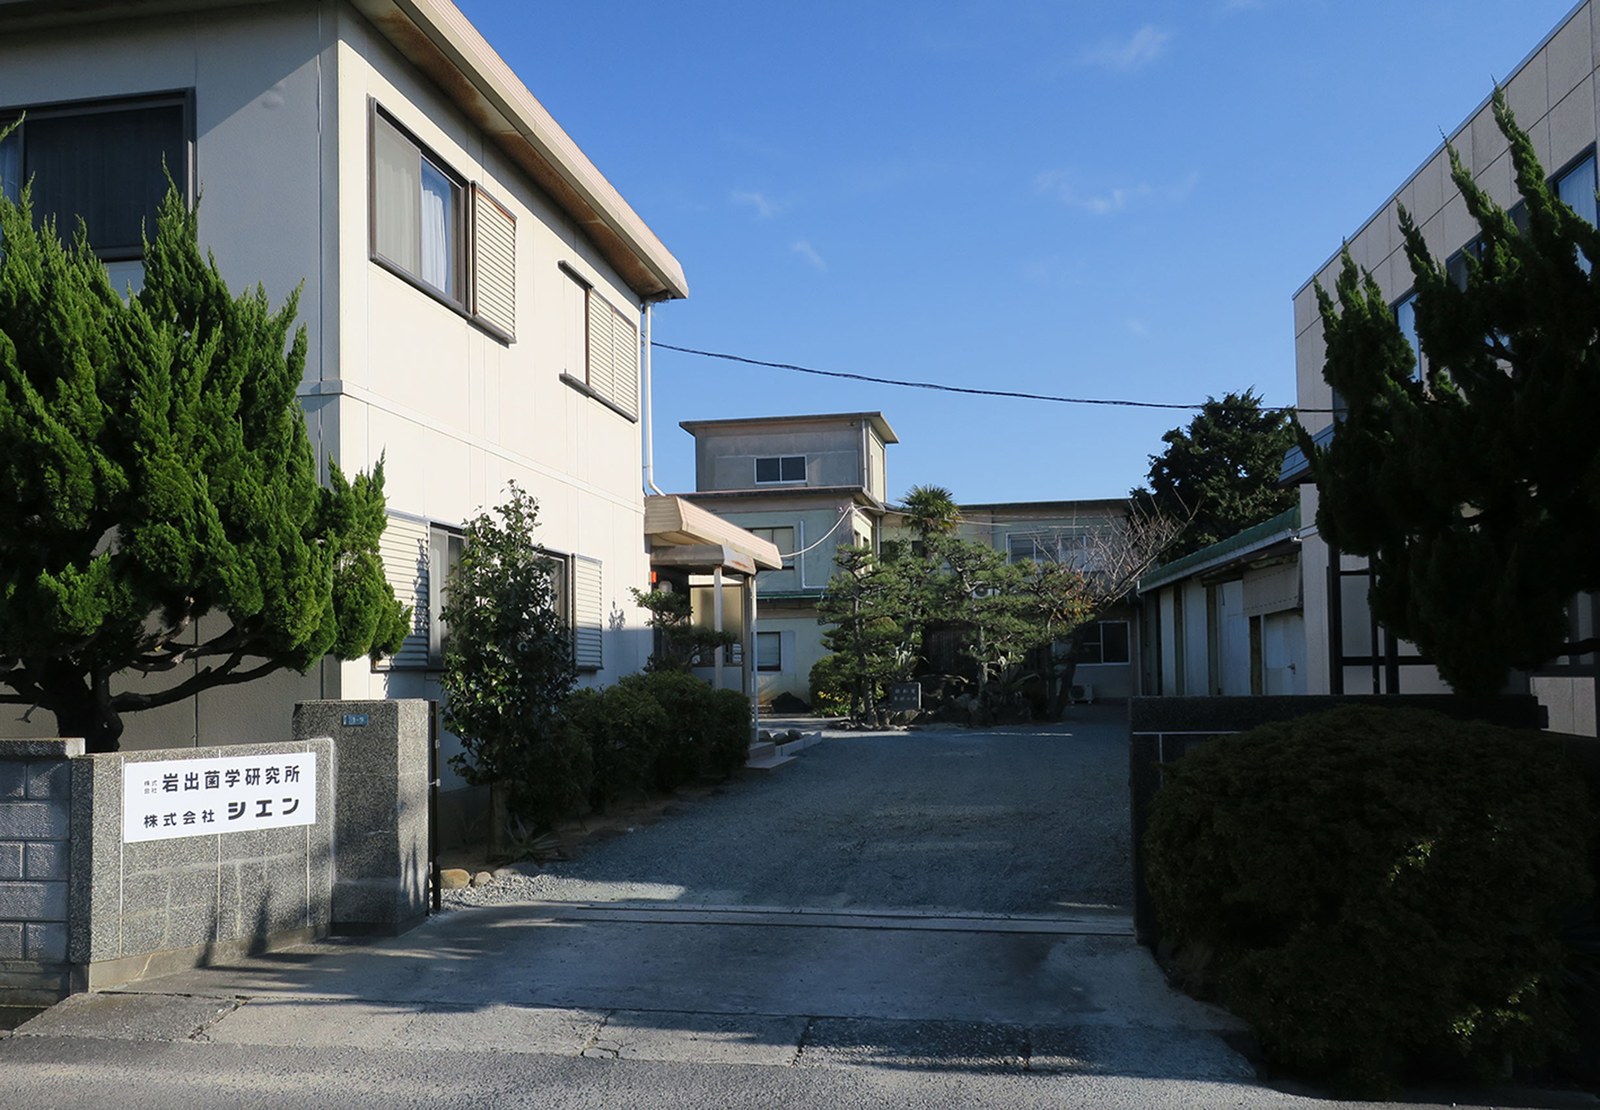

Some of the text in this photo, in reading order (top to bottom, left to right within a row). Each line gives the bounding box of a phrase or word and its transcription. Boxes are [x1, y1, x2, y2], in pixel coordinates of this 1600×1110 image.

[162, 765, 300, 793] 岩出菌学研究所
[144, 798, 299, 829] 株式会社 シエン
